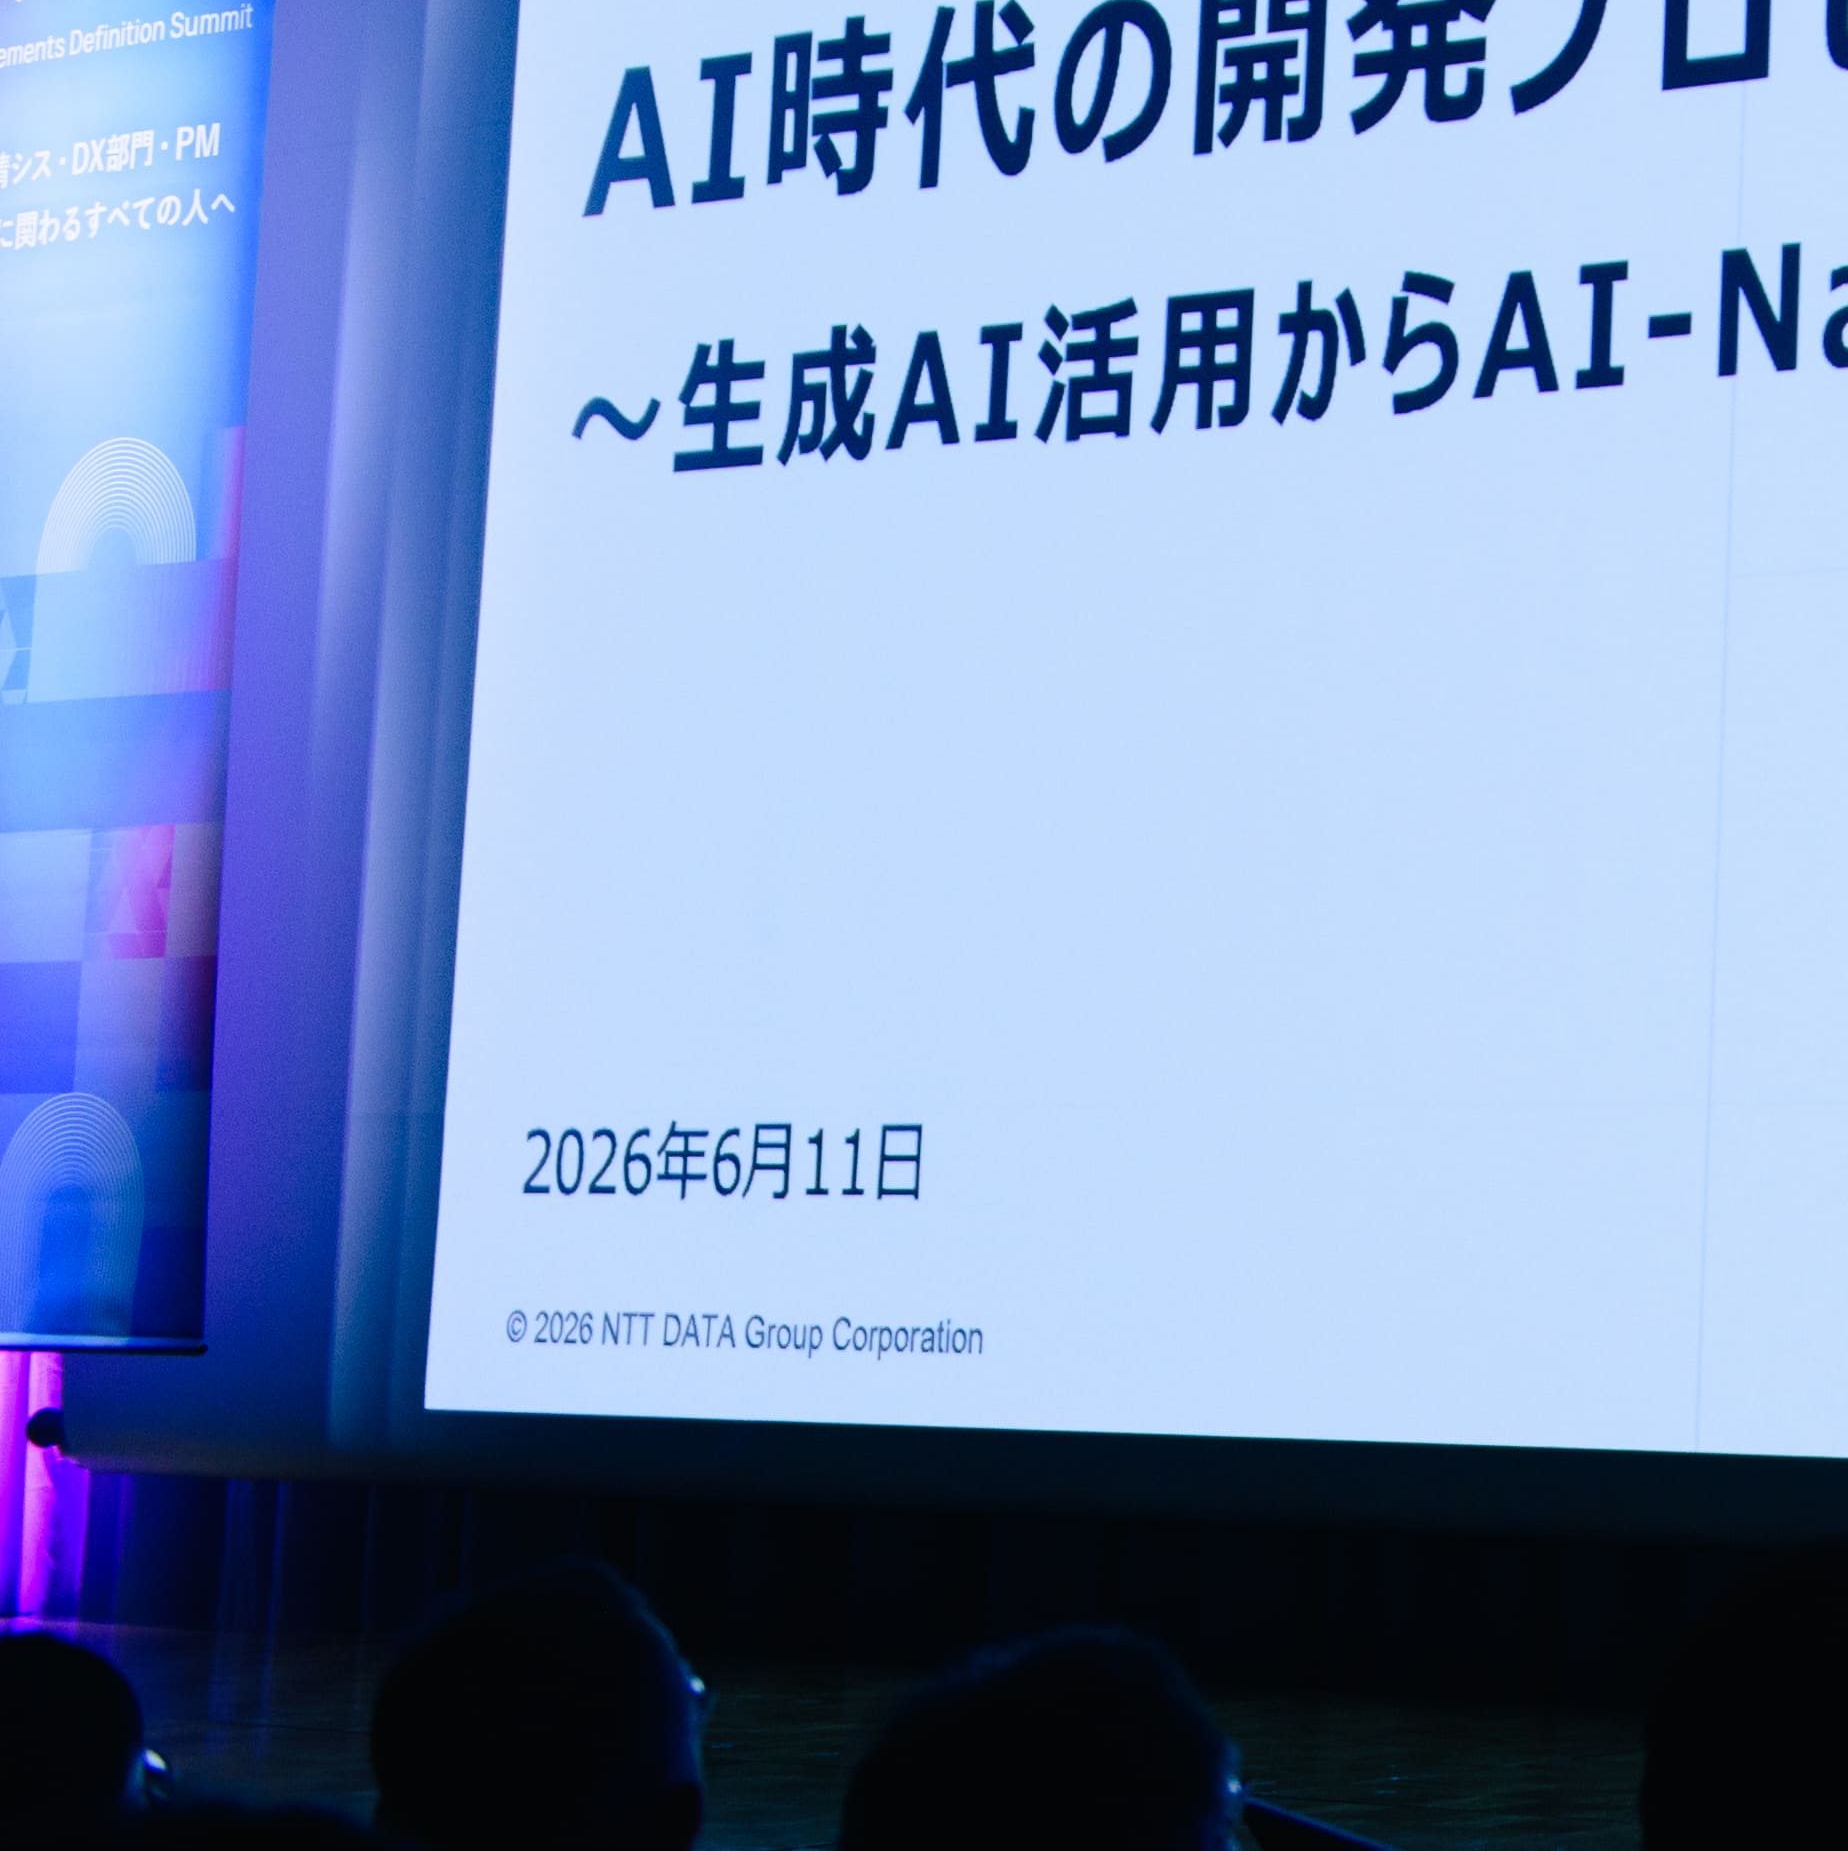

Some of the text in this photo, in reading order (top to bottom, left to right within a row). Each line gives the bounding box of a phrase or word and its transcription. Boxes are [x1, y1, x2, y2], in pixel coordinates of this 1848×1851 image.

[69, 19, 165, 57] Definition
[170, 3, 254, 39] Summit
[522, 1120, 924, 1200] 2026年6月11日
[533, 1312, 594, 1344] 2026
[601, 1313, 655, 1346] NTT
[663, 1314, 736, 1349] DATA
[744, 1315, 823, 1358] Group
[832, 1317, 984, 1360] Corporation
